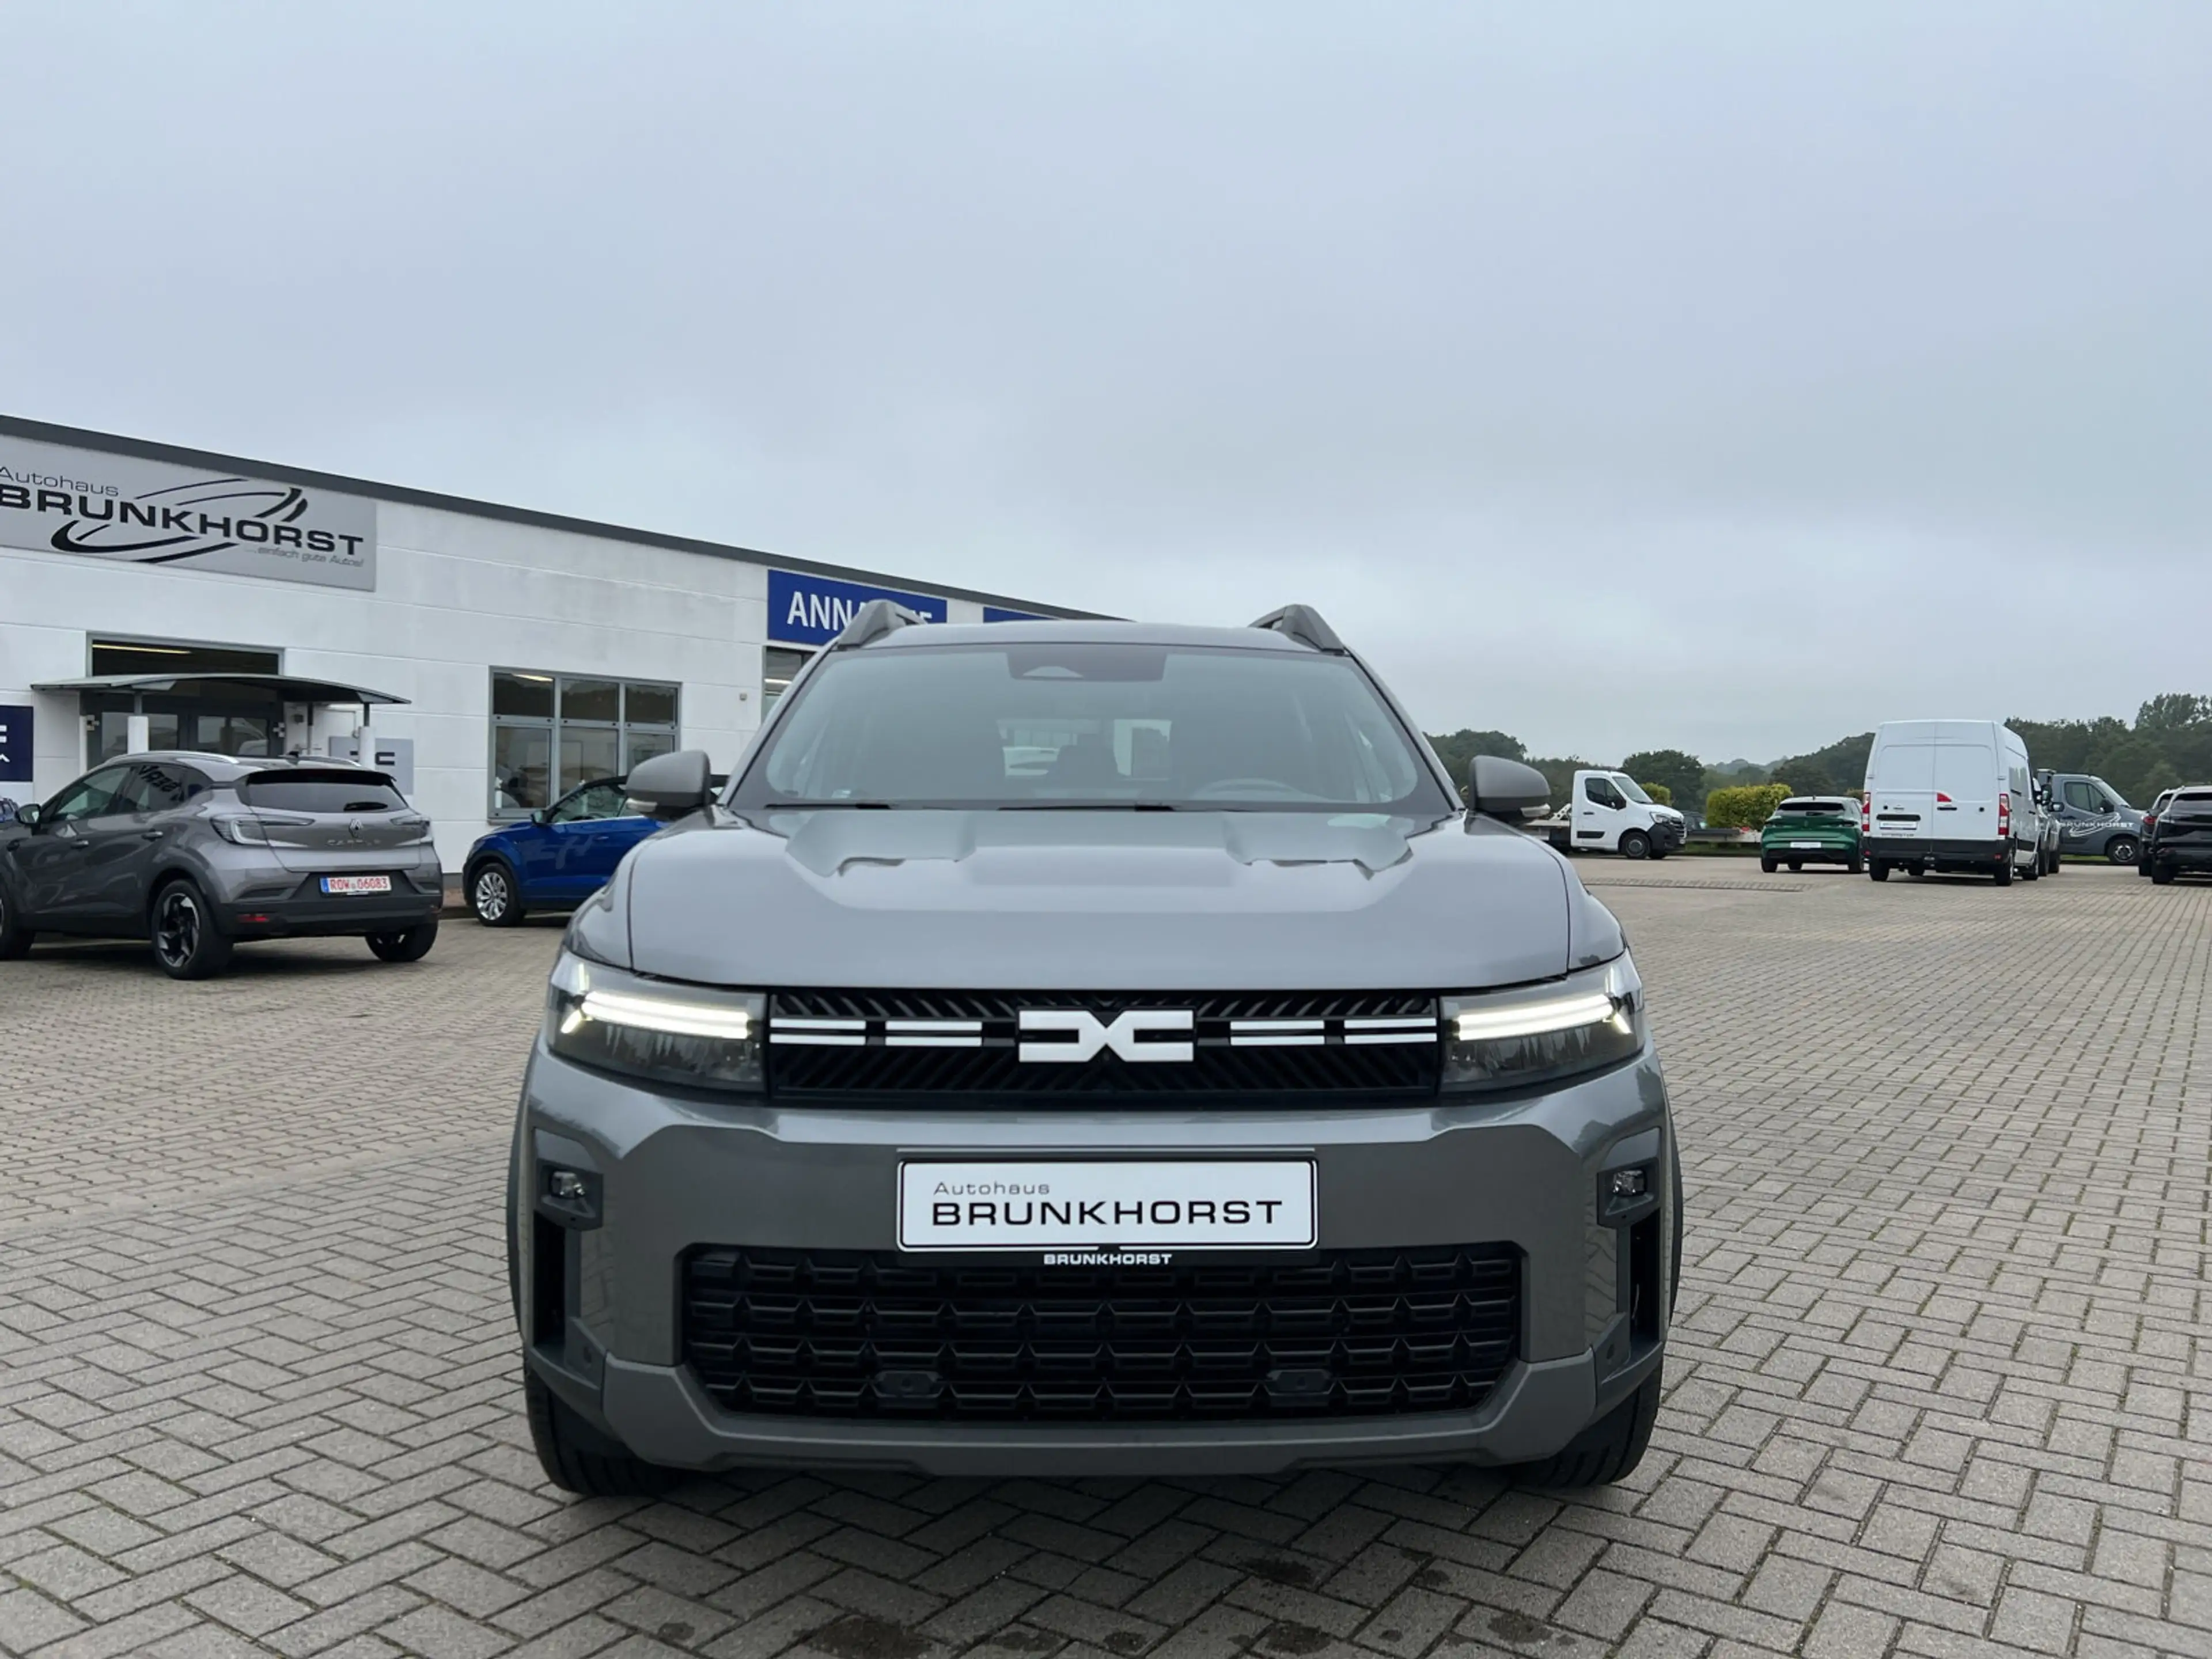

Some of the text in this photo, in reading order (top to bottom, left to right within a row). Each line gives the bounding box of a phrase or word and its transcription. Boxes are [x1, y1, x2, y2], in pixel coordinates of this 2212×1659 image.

[0, 465, 119, 497] Autohaus
[0, 483, 364, 555] BRUNKHORST
[933, 1181, 1050, 1196] Autohaus
[932, 1200, 1282, 1226] BRUNKHORST
[1043, 1253, 1172, 1265] BRUNKHORST
